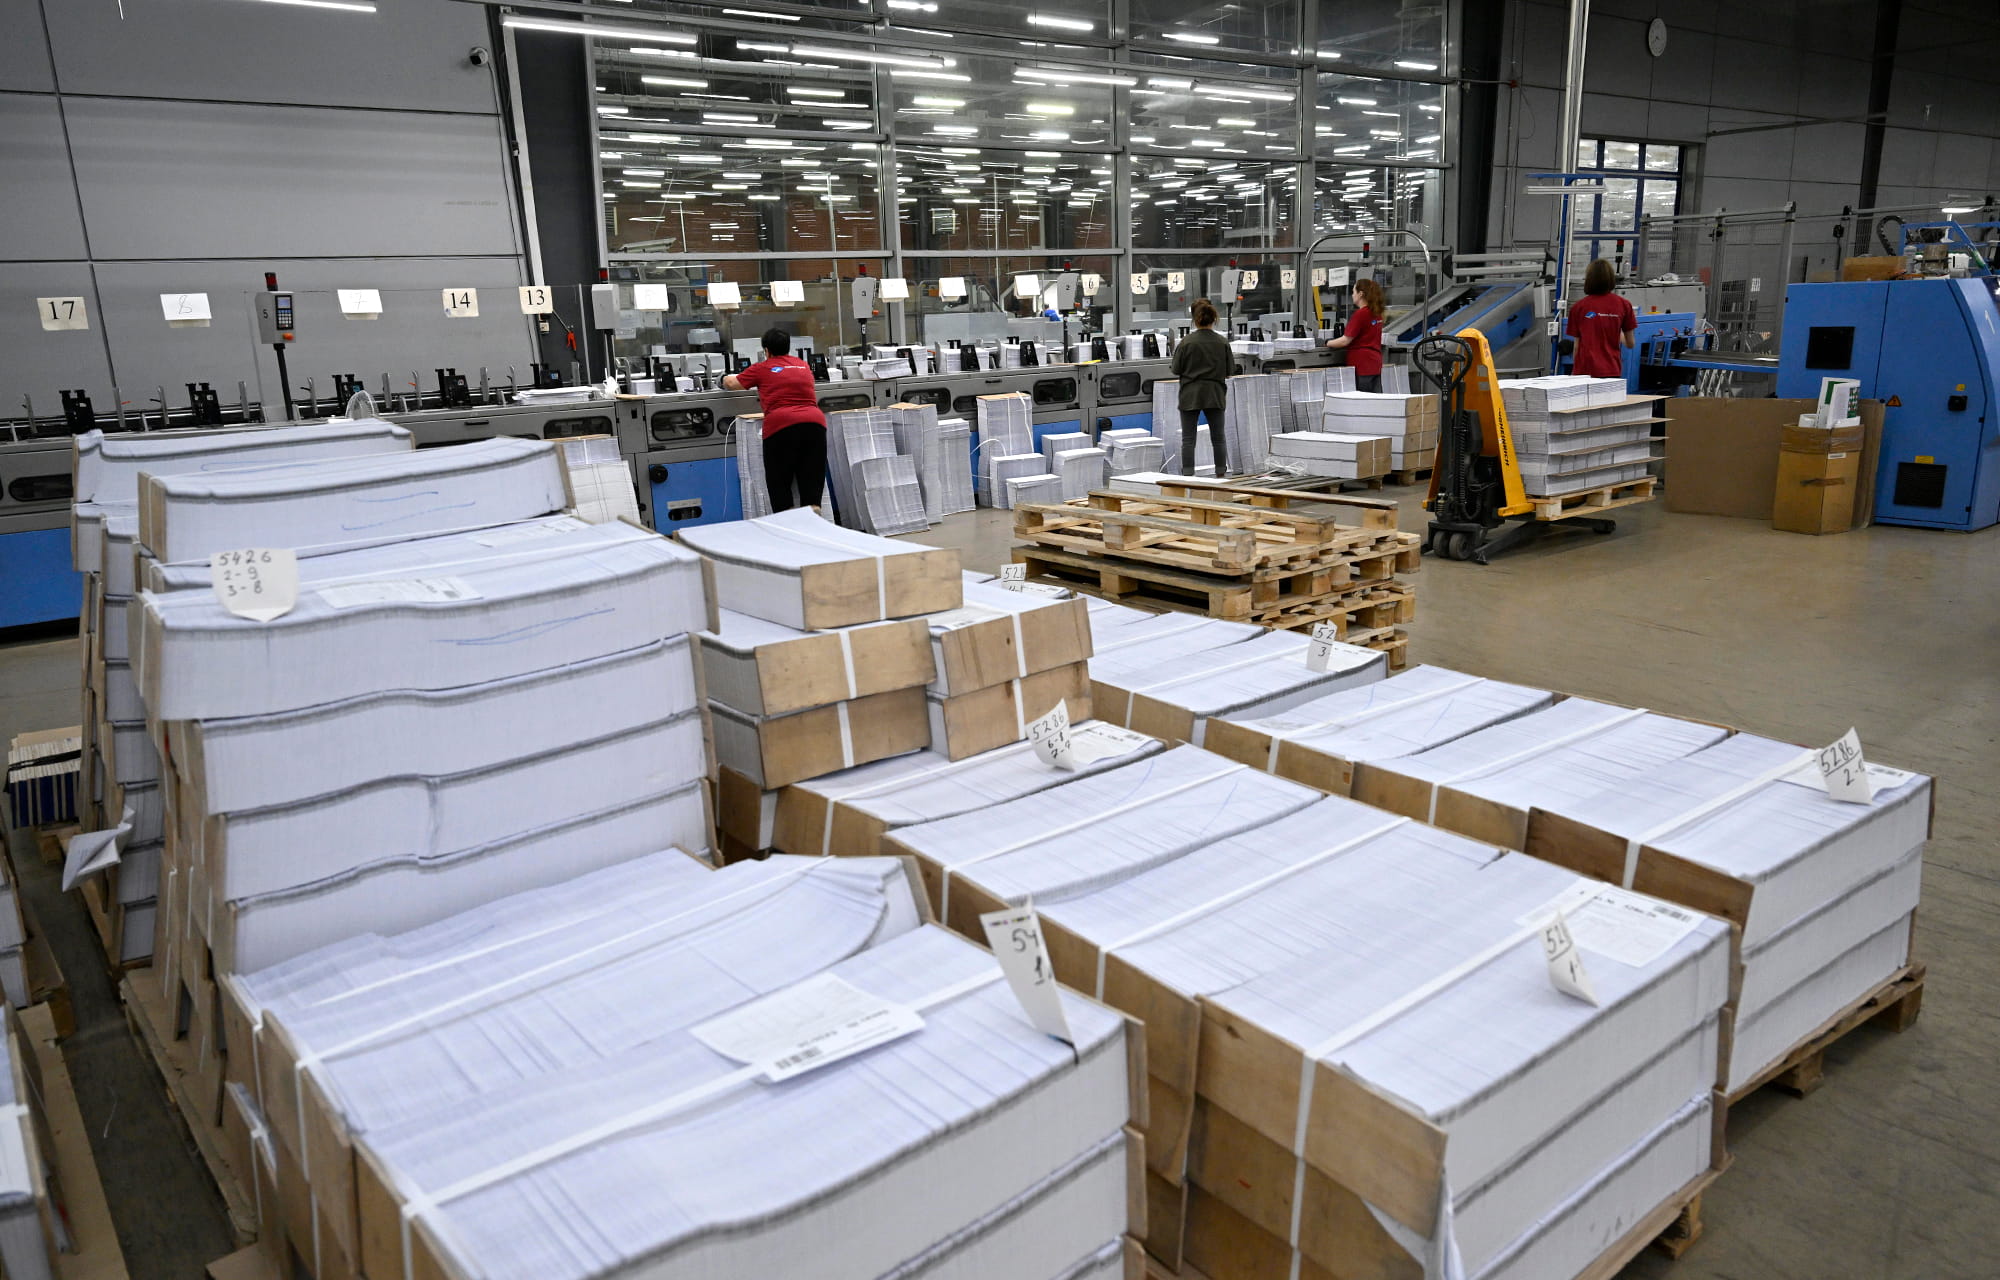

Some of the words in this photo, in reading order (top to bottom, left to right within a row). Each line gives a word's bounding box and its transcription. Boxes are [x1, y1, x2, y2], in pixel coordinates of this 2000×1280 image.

[451, 292, 471, 309] 14
[527, 289, 546, 306] 13
[48, 300, 75, 320] 17
[262, 308, 269, 319] 5
[218, 550, 272, 565] 5426
[1314, 627, 1335, 640] 52
[1317, 646, 1327, 657] 3
[1032, 710, 1065, 741] 5286
[1820, 739, 1854, 773] 5286
